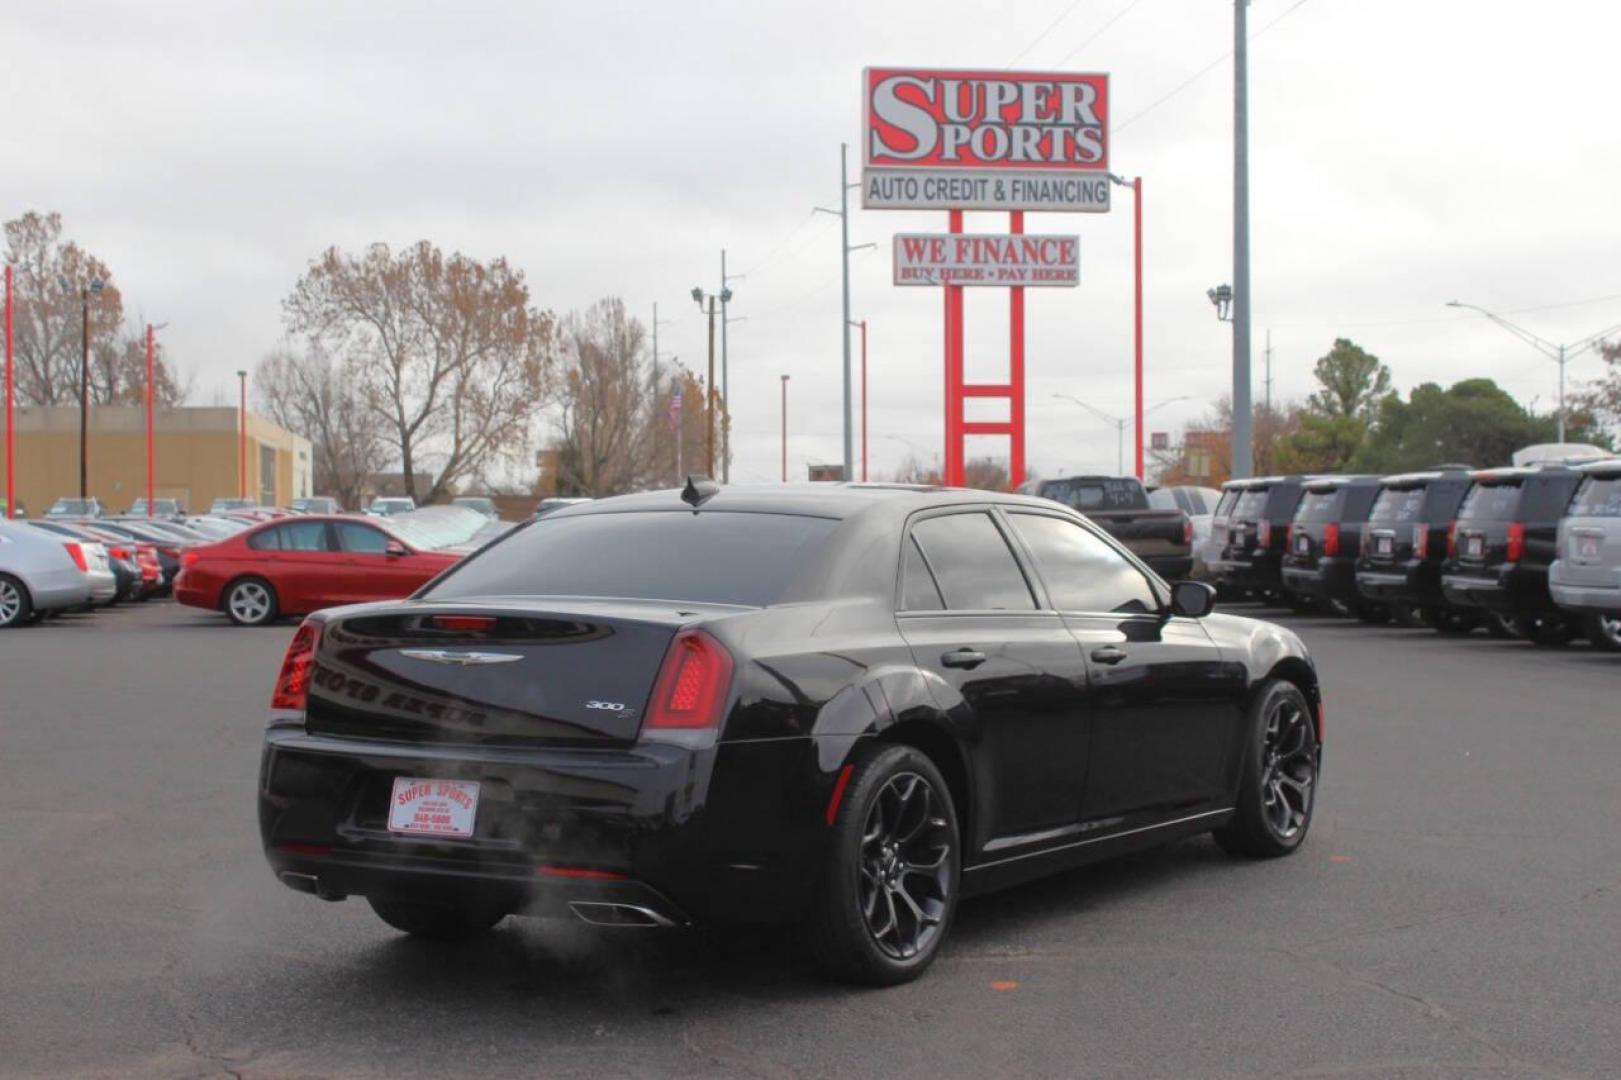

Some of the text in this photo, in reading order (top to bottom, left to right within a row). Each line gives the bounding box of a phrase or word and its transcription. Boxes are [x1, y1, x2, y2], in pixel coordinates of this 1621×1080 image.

[872, 75, 1101, 160] SUPER
[868, 177, 1108, 204] AUTO CREDIT & FINANCING
[902, 237, 1076, 266] WE FINANCE
[901, 267, 1077, 281] BUY HERE PAY HERE
[585, 700, 625, 711] 300
[399, 784, 473, 811] SUPER SPORTS
